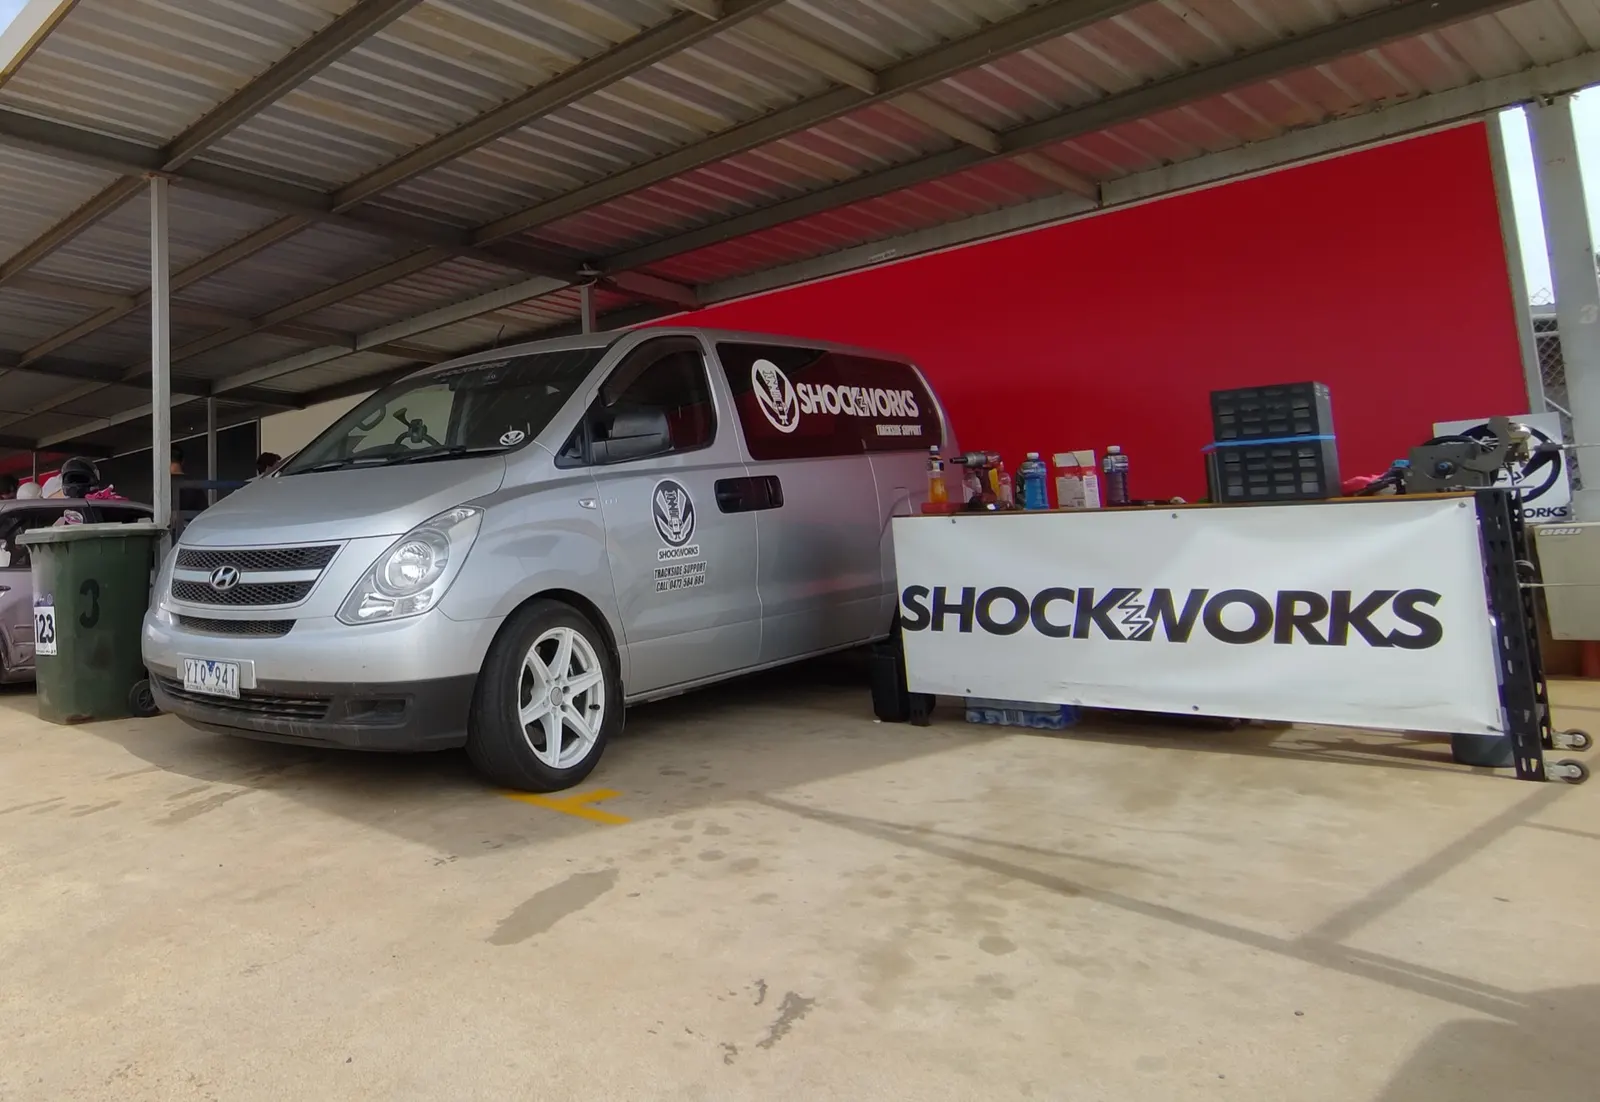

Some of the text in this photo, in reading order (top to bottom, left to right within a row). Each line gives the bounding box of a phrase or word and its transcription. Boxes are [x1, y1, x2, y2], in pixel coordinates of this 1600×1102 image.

[796, 382, 919, 418] SHOCKWORKS
[1523, 506, 1567, 518] ORKS
[658, 546, 699, 560] SHOCKWORKS
[655, 562, 706, 579] TRACKSIDE SUPPORT
[657, 581, 668, 592] CALL
[80, 578, 100, 629] 3
[35, 613, 55, 644] 123
[900, 584, 1443, 650] SHOCKWORKS
[215, 665, 235, 690] 941
